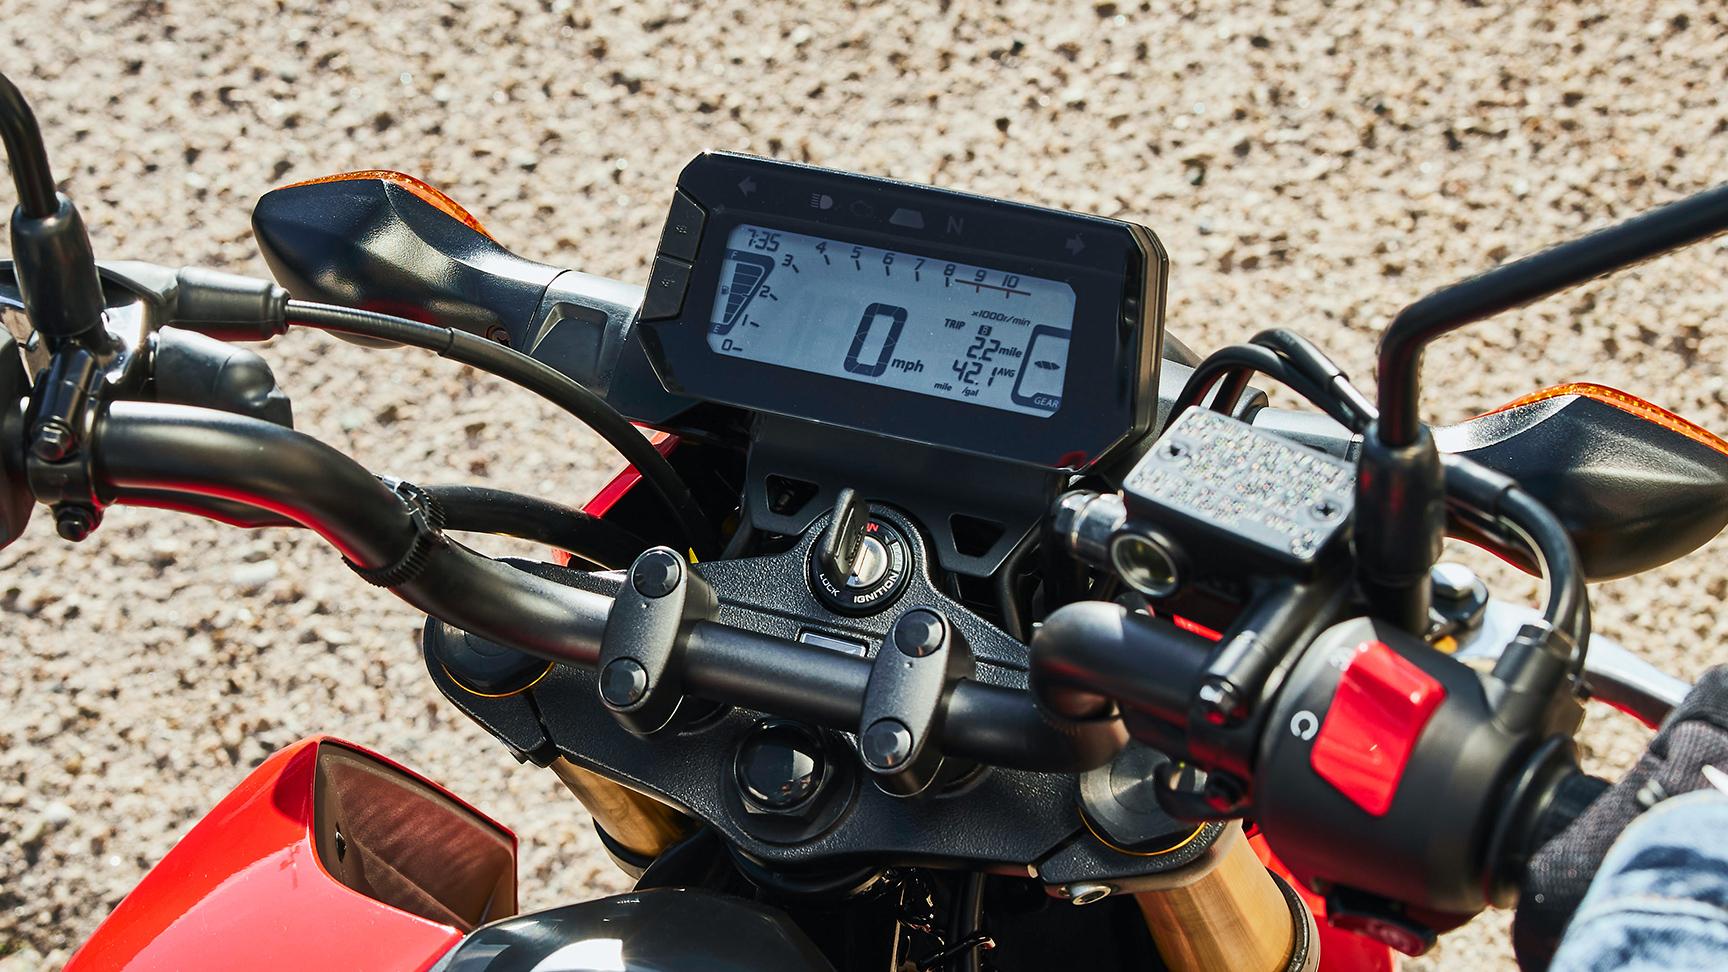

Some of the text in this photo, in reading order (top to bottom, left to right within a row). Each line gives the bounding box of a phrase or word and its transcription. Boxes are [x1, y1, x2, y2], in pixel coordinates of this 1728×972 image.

[946, 216, 964, 235] N
[747, 228, 782, 252] 7:35
[730, 252, 738, 260] F
[781, 254, 794, 267] 3
[815, 241, 1019, 288] 4 5 6 7 8 9 10
[759, 285, 771, 298] 2
[741, 314, 748, 326] 1
[944, 318, 966, 330] TRIP
[713, 325, 720, 333] E
[721, 338, 733, 352] 0
[843, 302, 924, 377] 0 mph
[966, 336, 1023, 361] 2.2 mile
[952, 359, 1016, 387] 42.1 AVG
[934, 381, 979, 398] mile /gal
[1034, 396, 1059, 409] GEAR
[819, 573, 841, 597] LOCK
[853, 572, 899, 604] IGNITION
